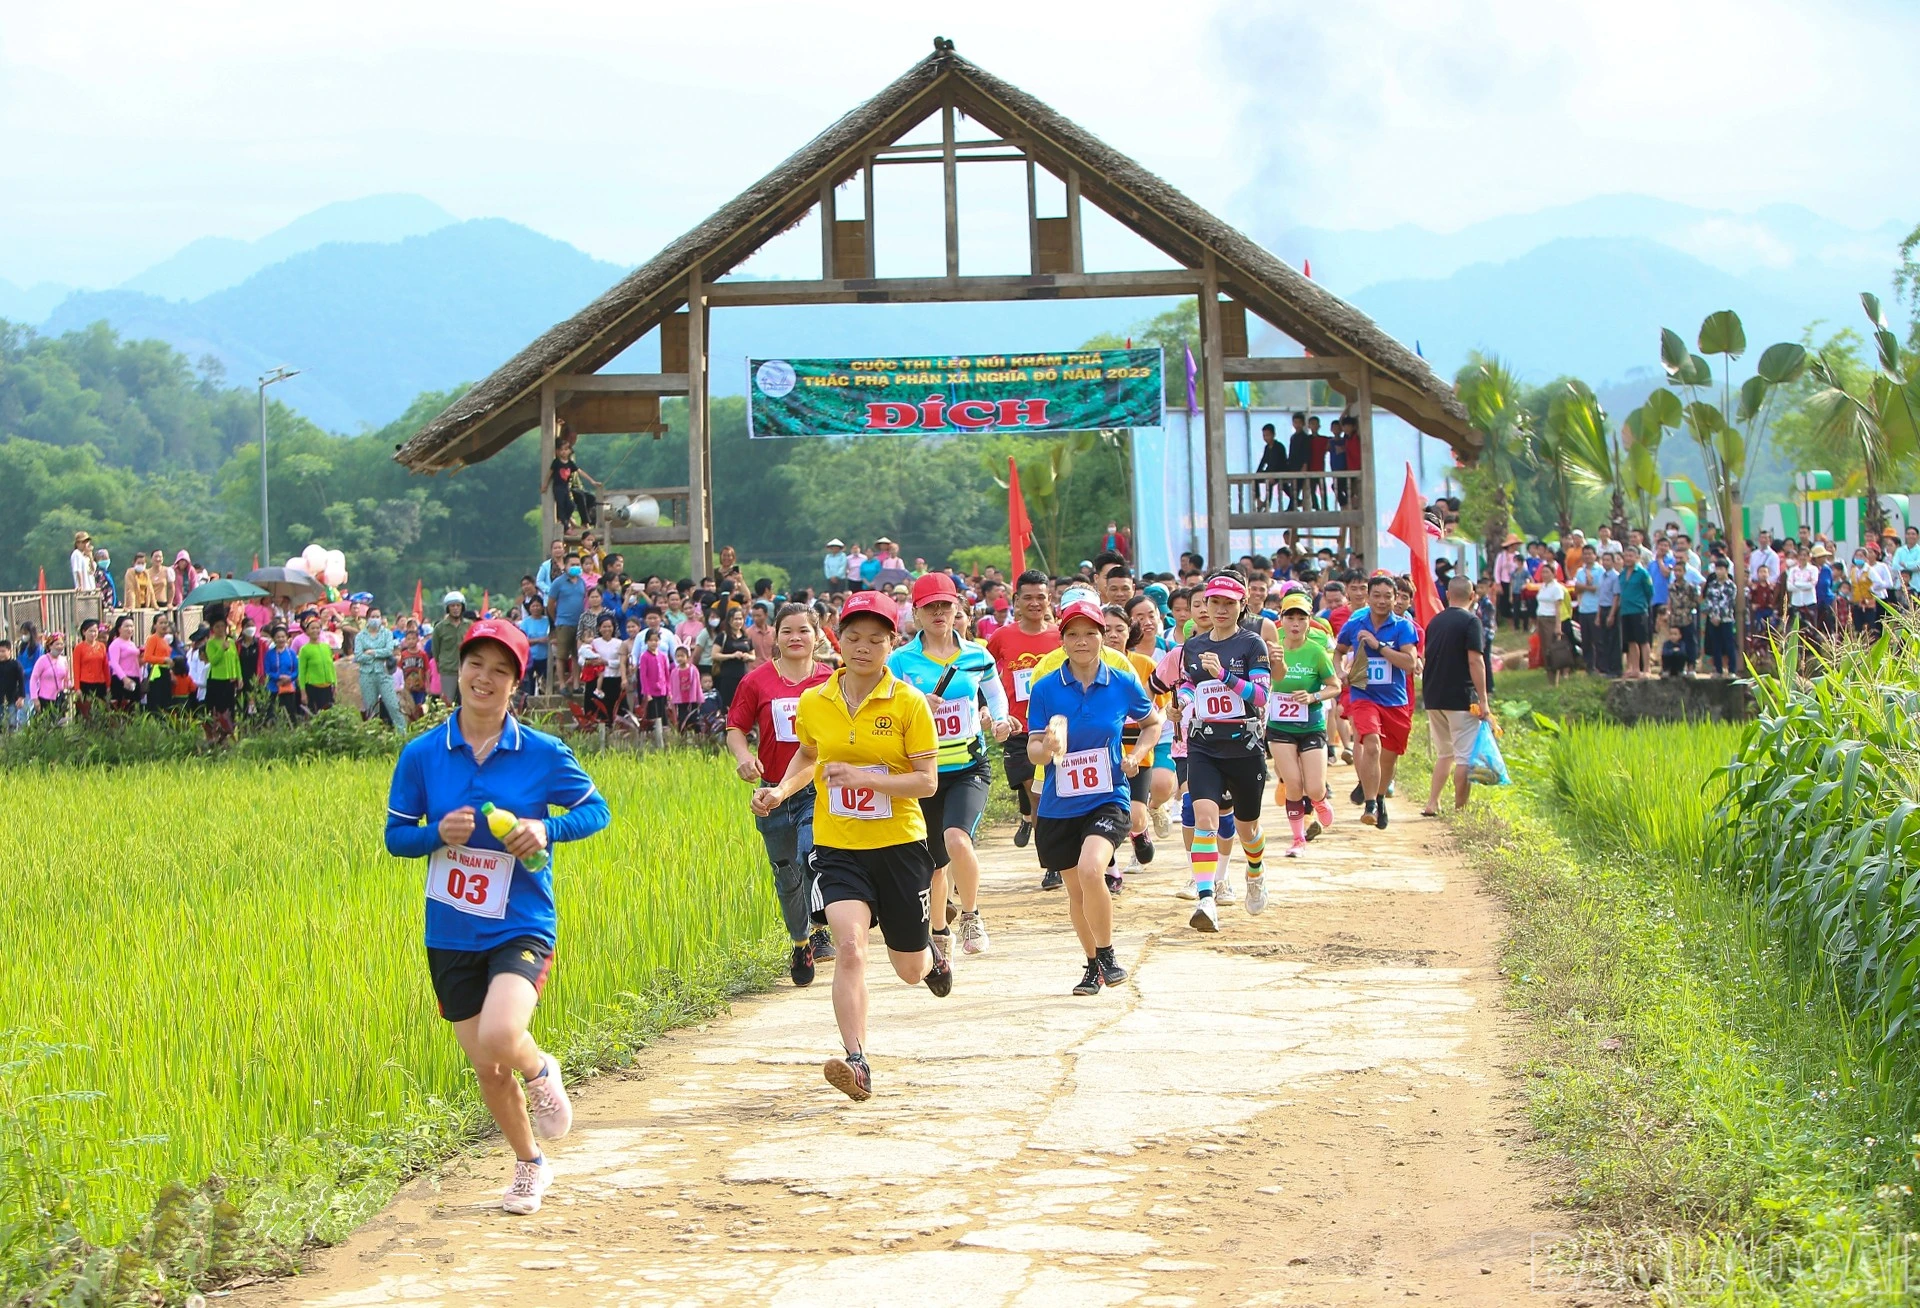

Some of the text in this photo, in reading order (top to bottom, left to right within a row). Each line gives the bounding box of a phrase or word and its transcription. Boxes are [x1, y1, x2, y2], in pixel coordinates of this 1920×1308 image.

[851, 352, 1103, 372] CUỘC THI LEO NÚI KHÁM PHÁ
[803, 373, 849, 387] THÁC
[895, 372, 942, 385] PHÂN
[947, 370, 970, 384] XÃ
[975, 368, 1027, 383] NGHĨA
[1033, 368, 1058, 382] ĐÔ
[1063, 368, 1101, 381] NĂM
[1106, 367, 1151, 379] 2023
[865, 394, 1050, 429] ĐÍCH
[1367, 667, 1384, 681] 10
[1207, 695, 1233, 715] 06
[1279, 703, 1300, 718] 22
[872, 729, 893, 737] GUCCI
[935, 715, 961, 736] 09
[1067, 766, 1099, 790] 18
[841, 786, 876, 812] 02
[459, 853, 482, 868] NHÂN
[483, 857, 499, 870] NỮ
[447, 868, 490, 905] 03
